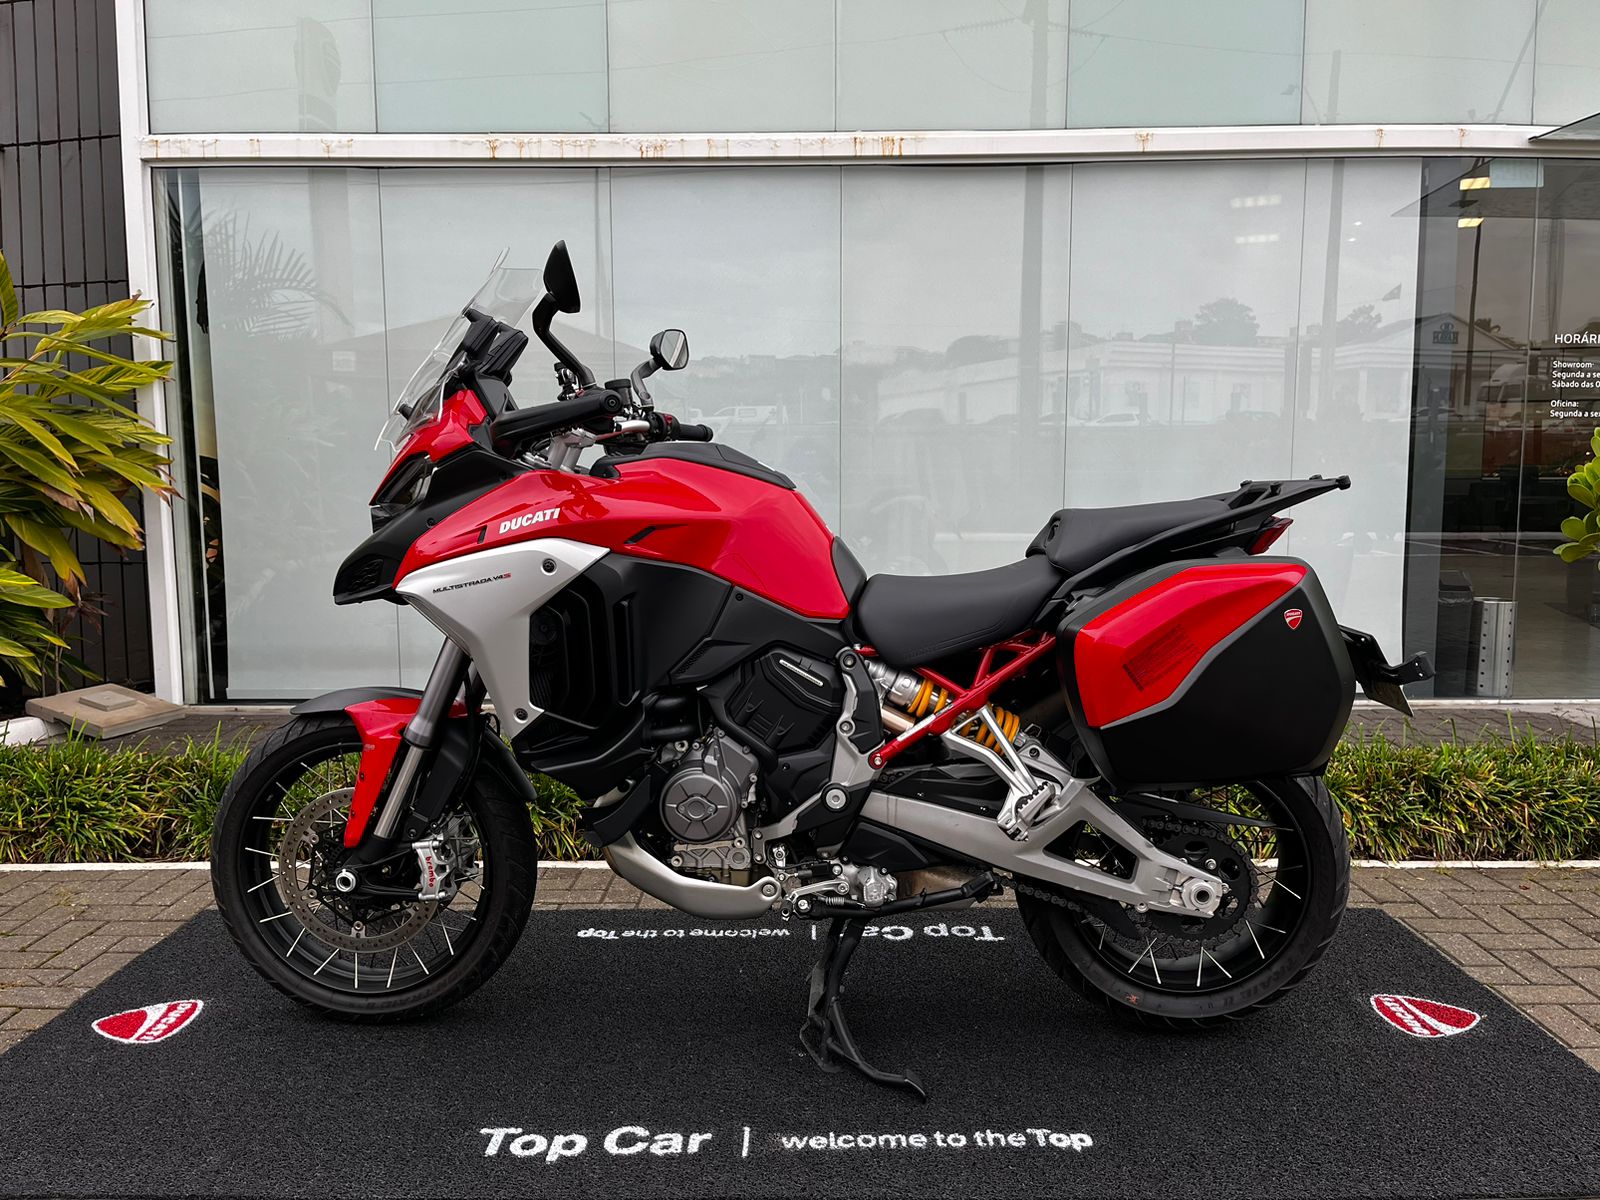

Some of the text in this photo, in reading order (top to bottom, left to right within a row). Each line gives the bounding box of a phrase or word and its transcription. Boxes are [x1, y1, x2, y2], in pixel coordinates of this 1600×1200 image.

[1554, 331, 1600, 344] HORÁRI
[1552, 370, 1585, 379] Segunda
[1551, 380, 1579, 388] Sábado
[1581, 380, 1594, 388] das
[1550, 409, 1582, 419] Segunda
[499, 508, 560, 534] DUCATI
[432, 577, 493, 594] MULTISTRADA
[425, 855, 436, 888] brembo
[577, 922, 1005, 941] Top Ca welcome to the Top
[479, 1126, 1094, 1164] Top Car welcome to the Top
